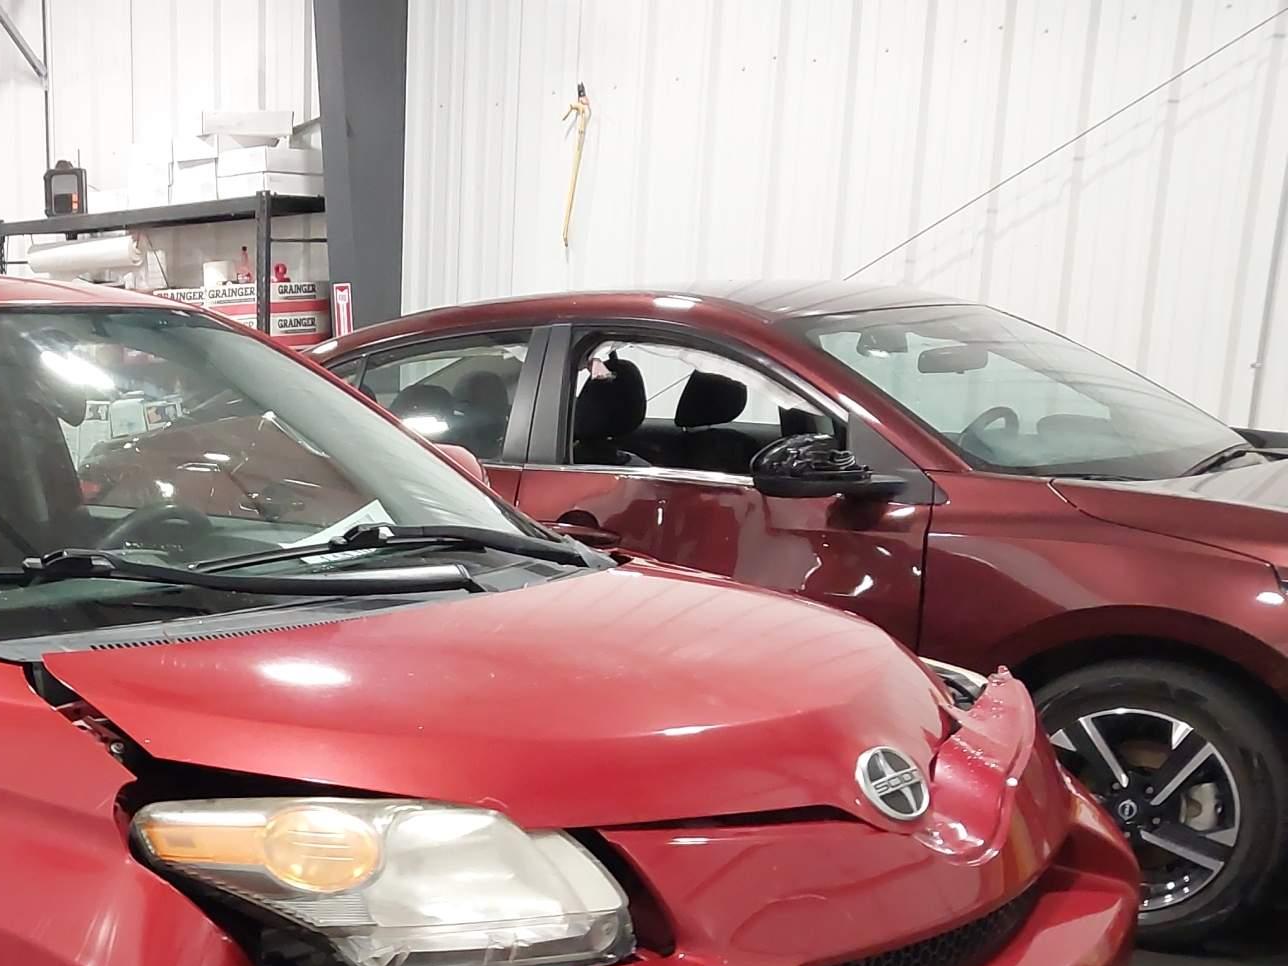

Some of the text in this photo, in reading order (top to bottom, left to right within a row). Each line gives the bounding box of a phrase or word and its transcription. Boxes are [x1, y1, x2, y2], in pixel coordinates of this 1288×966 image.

[208, 286, 255, 299] GRAINGER
[278, 284, 316, 294] GRAINGER
[278, 318, 316, 328] GRAINGER
